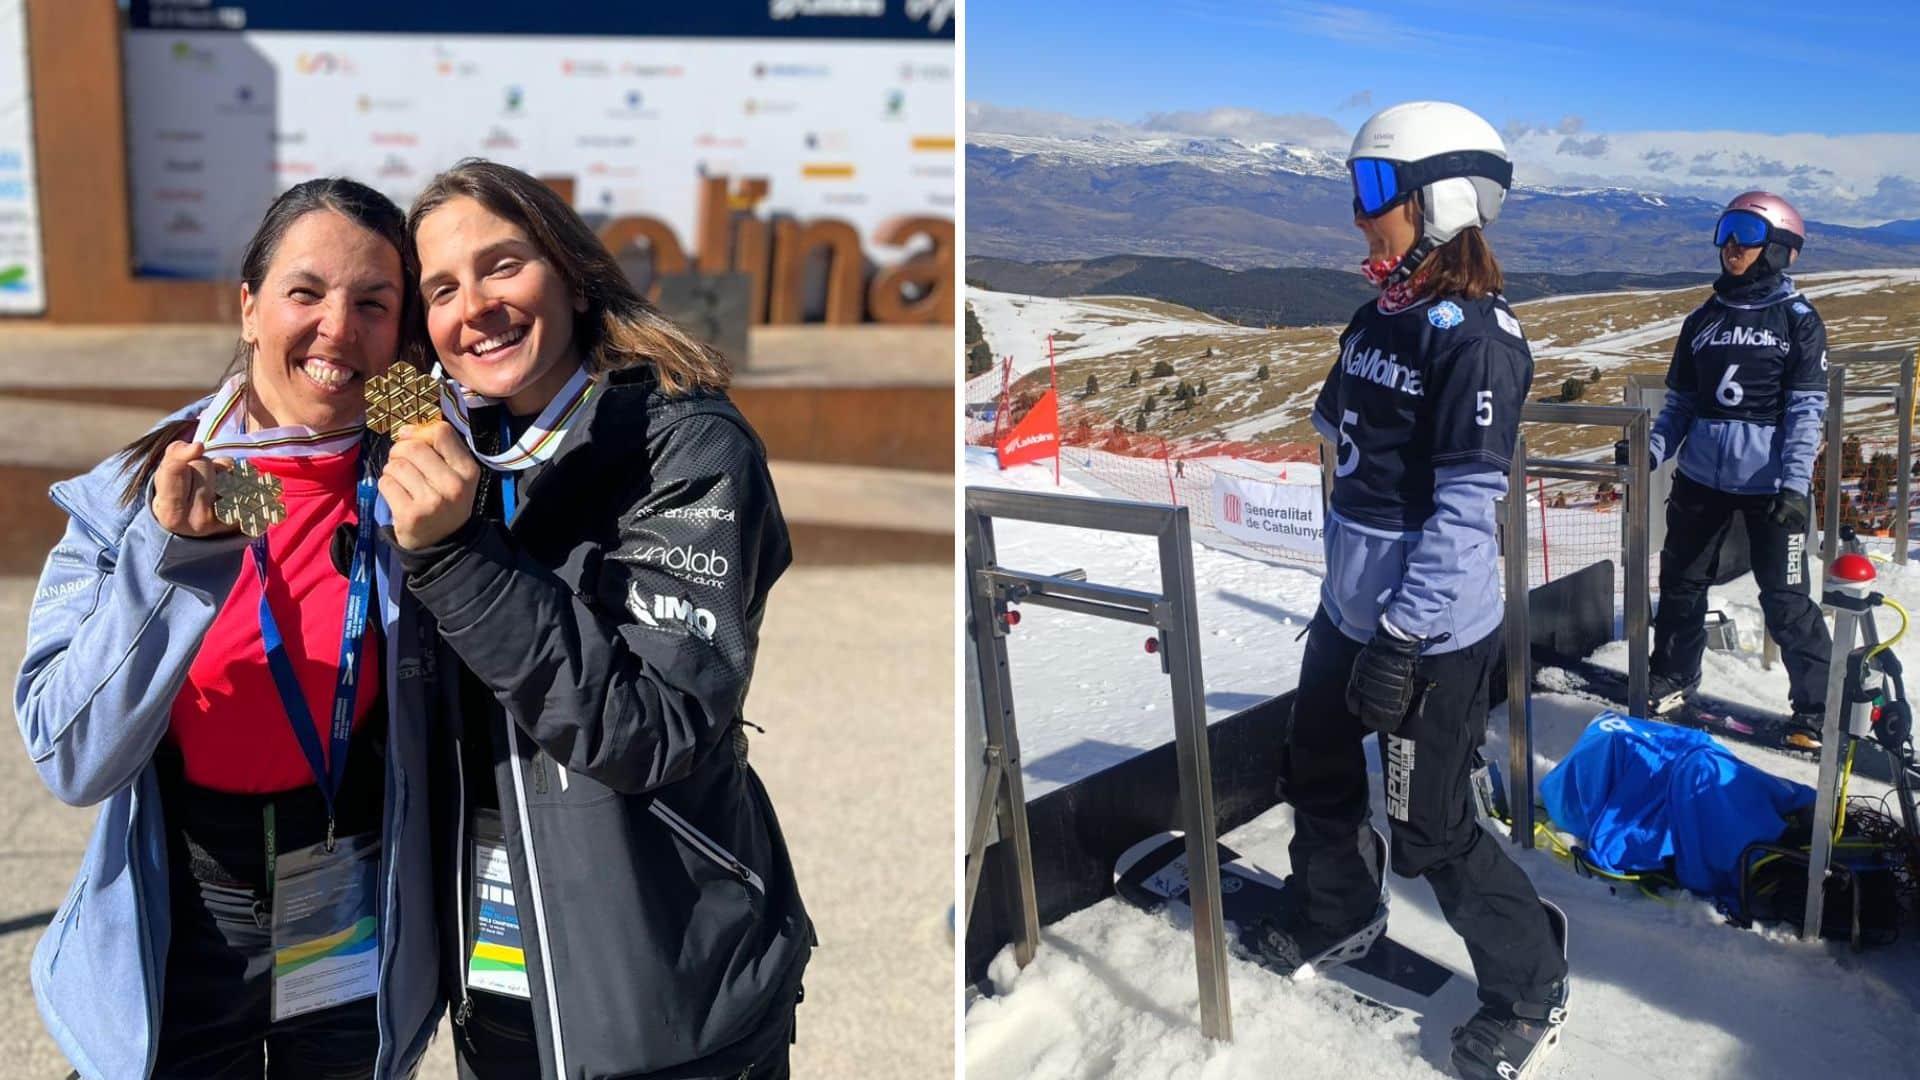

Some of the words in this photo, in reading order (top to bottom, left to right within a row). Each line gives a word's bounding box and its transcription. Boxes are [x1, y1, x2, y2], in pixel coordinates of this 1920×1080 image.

[1820, 350, 1829, 372] 6
[1715, 363, 1744, 407] 6
[1475, 390, 1493, 426] 5
[1335, 408, 1360, 478] 5
[1244, 502, 1313, 522] Generalitat
[1246, 517, 1261, 529] de
[1262, 519, 1325, 541] Catalunya
[1787, 533, 1799, 586] SPAIN
[1387, 733, 1401, 820] SPAIN
